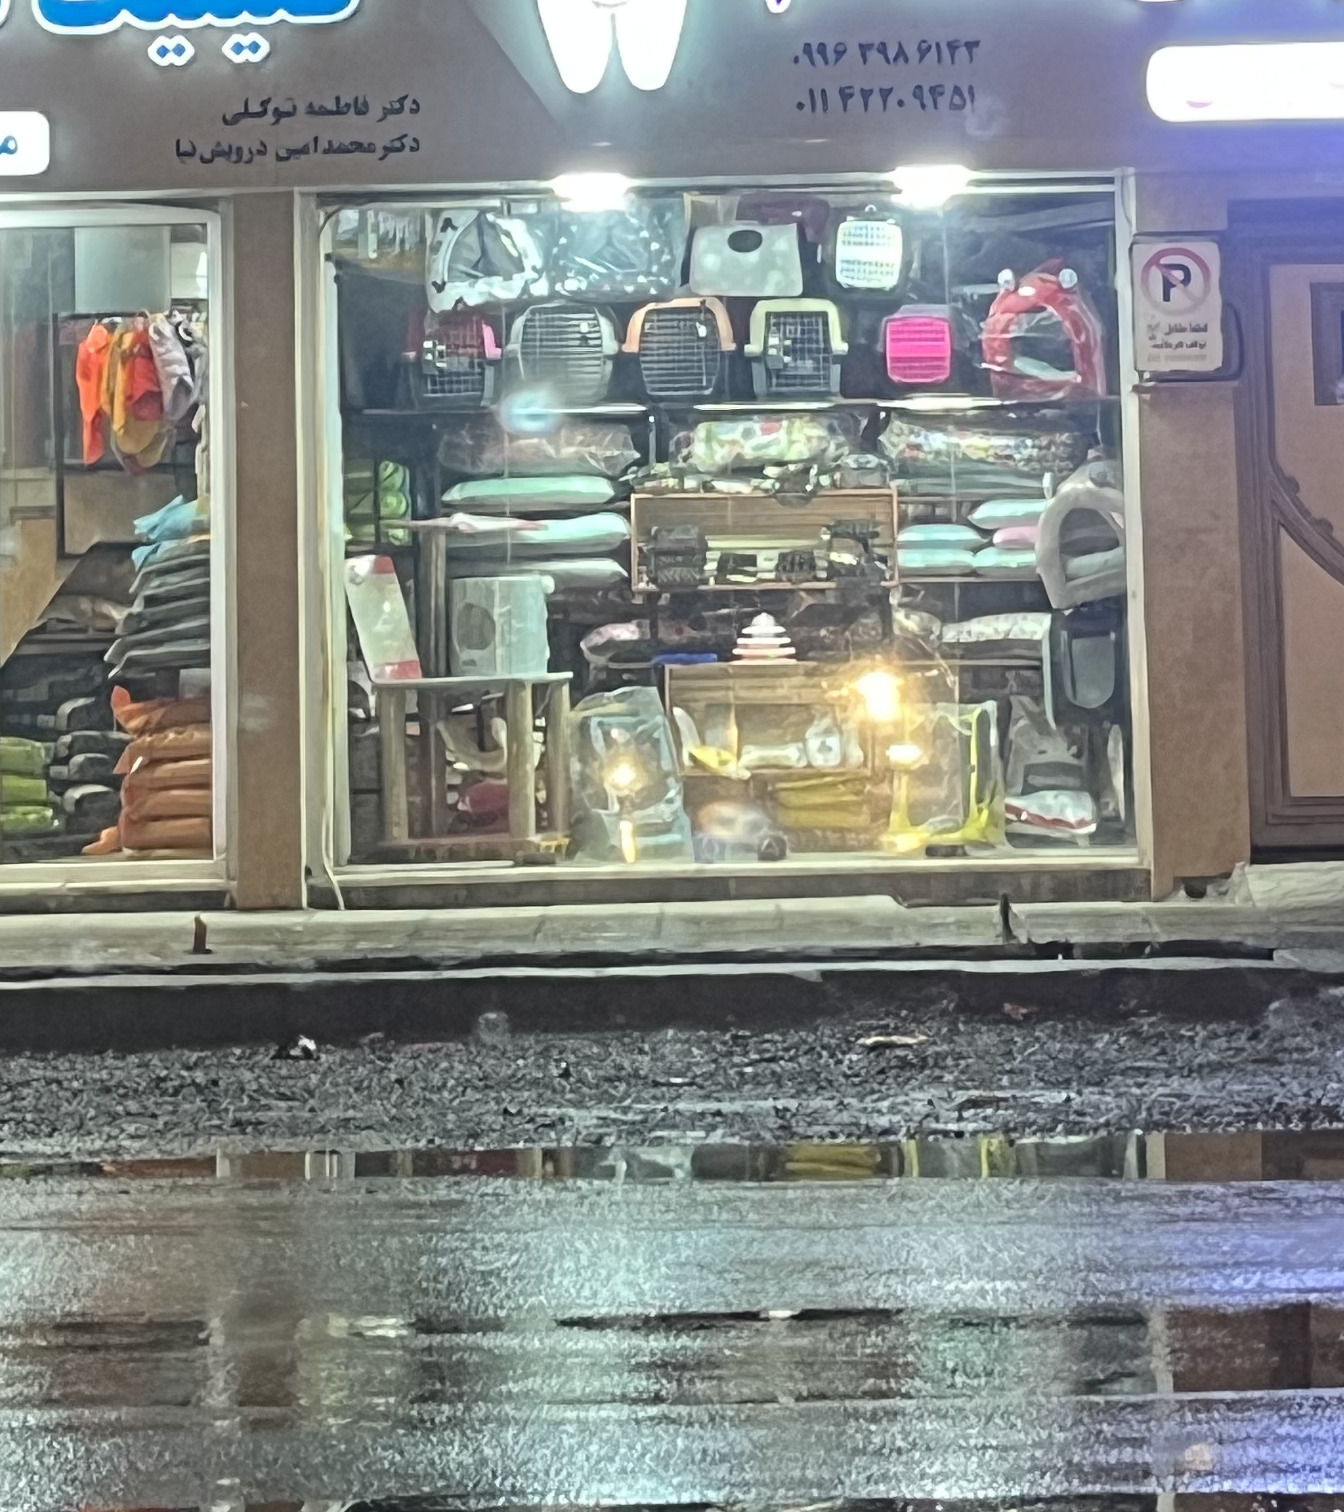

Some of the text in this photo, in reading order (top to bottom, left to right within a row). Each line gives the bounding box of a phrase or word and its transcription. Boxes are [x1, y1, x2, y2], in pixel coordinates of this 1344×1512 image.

[222, 93, 420, 126] دکتر فاطمه توکلی
[378, 134, 420, 160] دکتر
